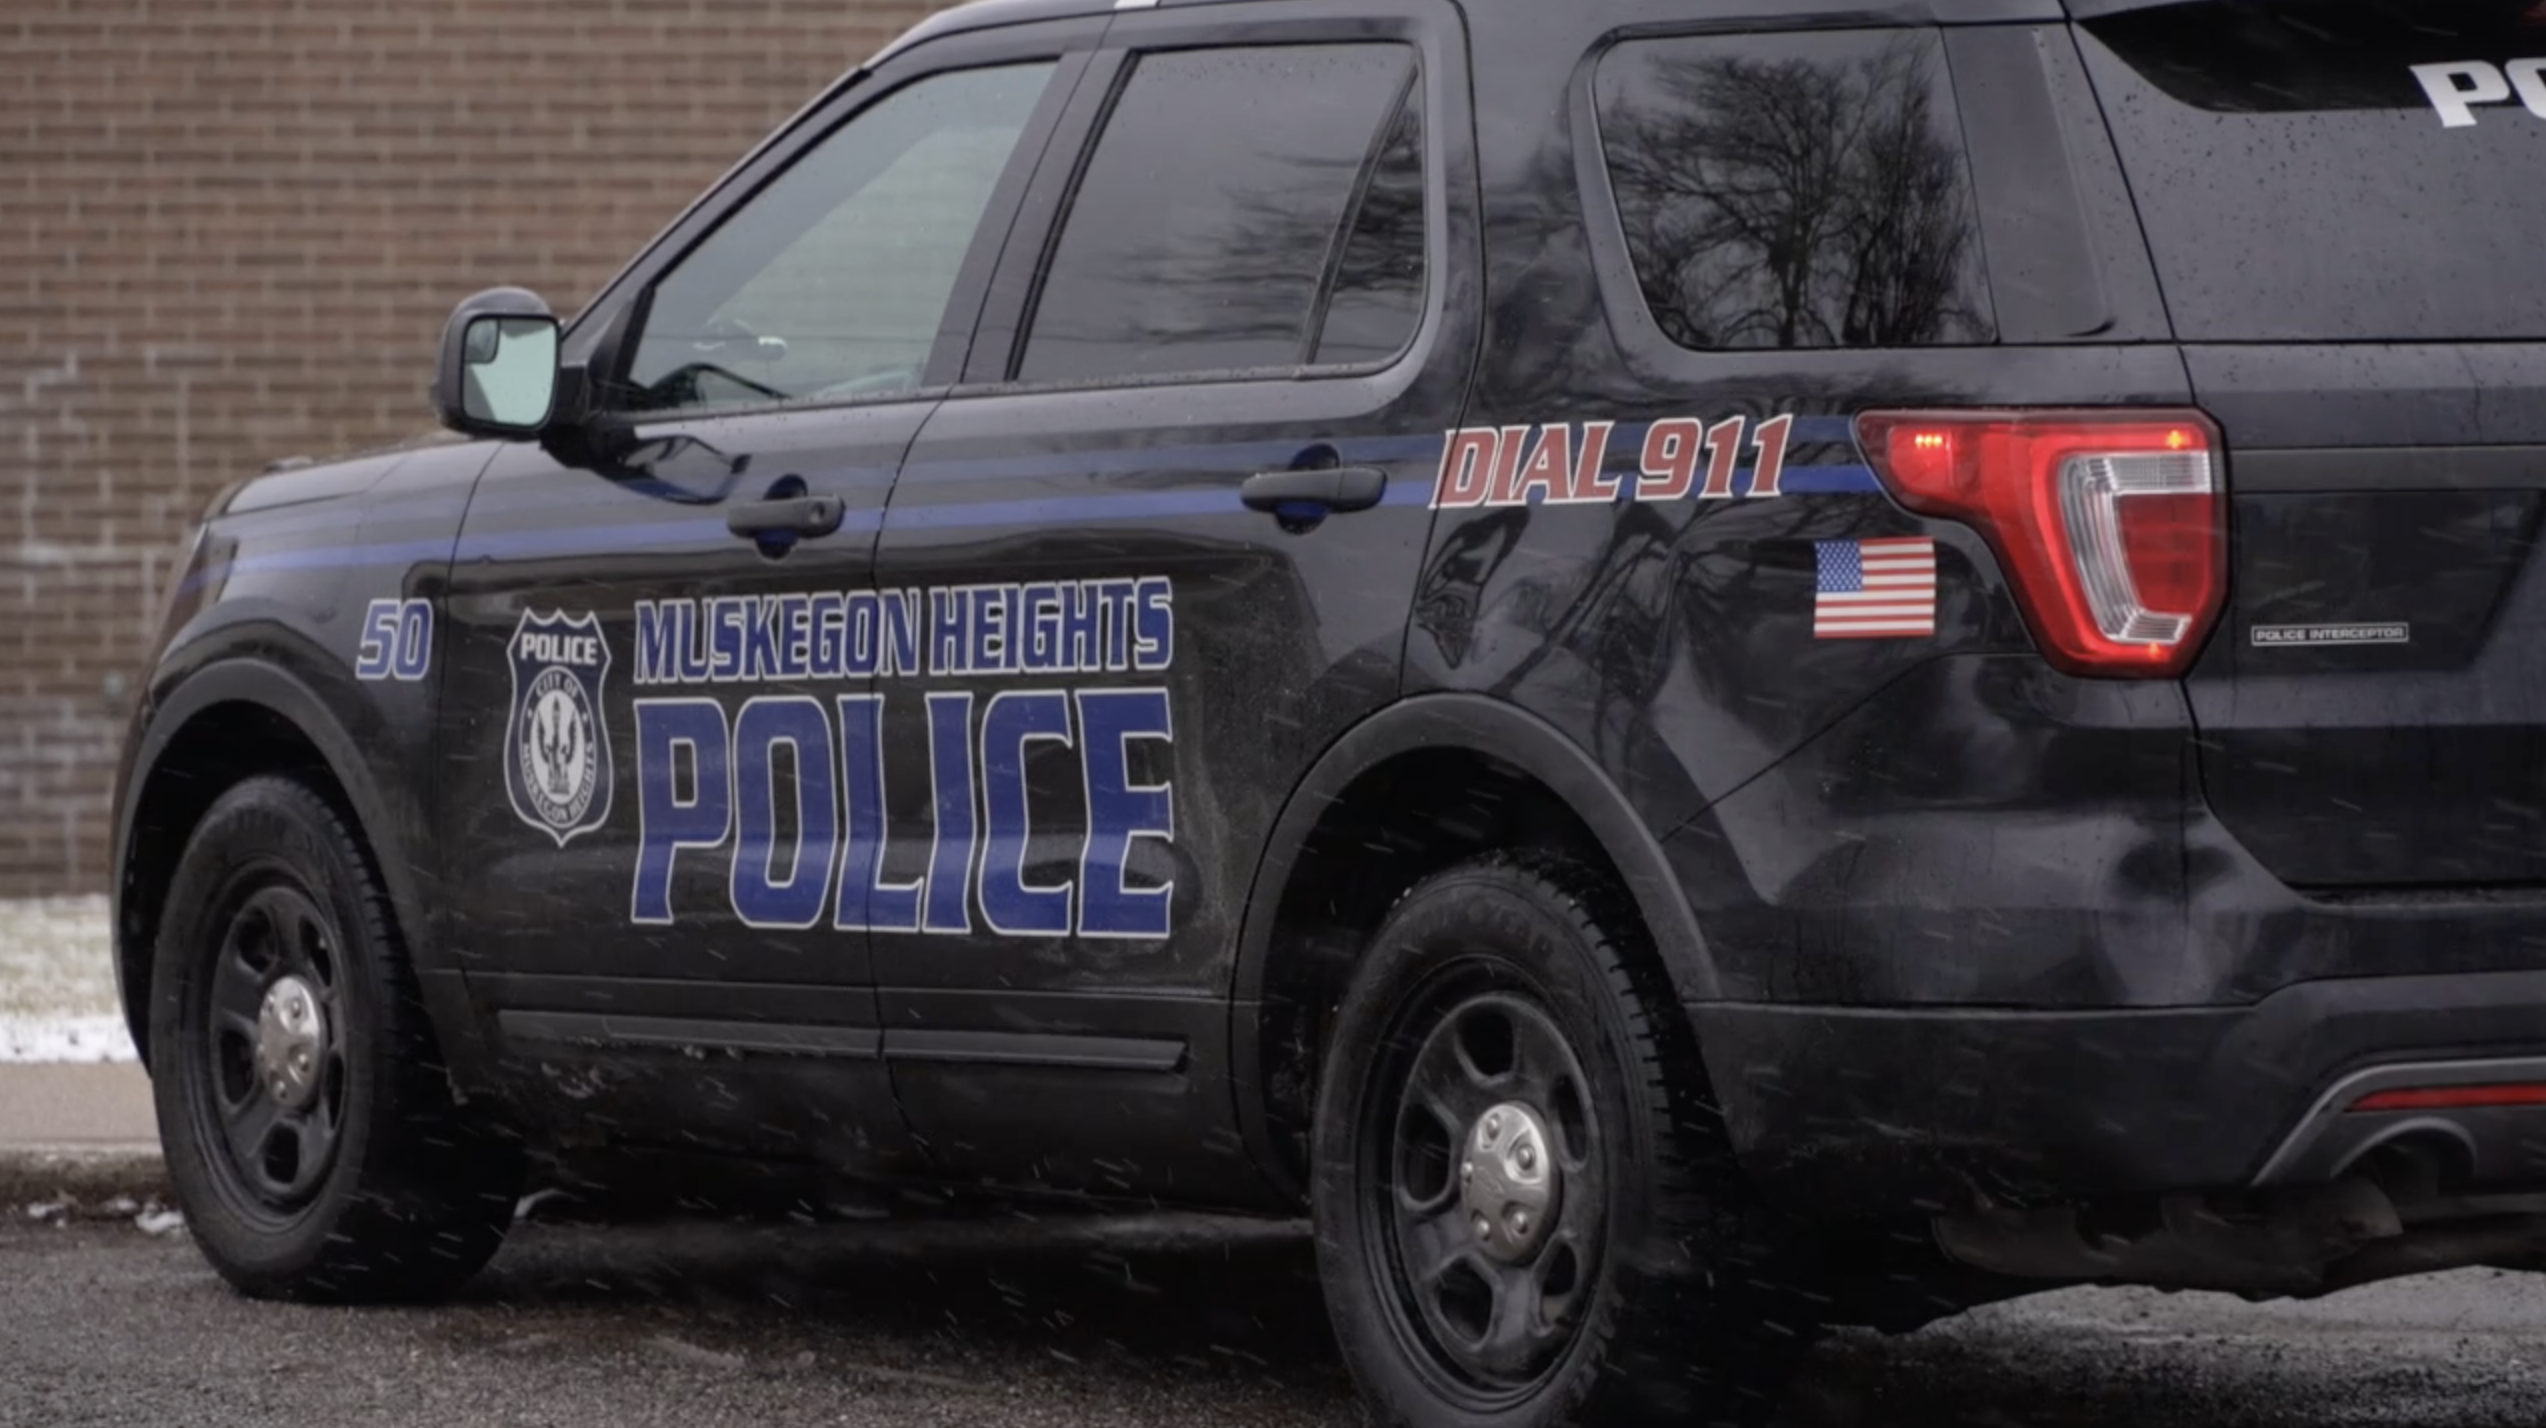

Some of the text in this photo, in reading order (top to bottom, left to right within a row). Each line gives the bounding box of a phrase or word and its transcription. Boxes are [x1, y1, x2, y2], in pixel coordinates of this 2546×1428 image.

[1428, 413, 1793, 510] DIAL 911
[355, 597, 434, 680] 50
[520, 632, 597, 666] POLICE
[633, 576, 1173, 684] MUSKEGON HEIGHTS
[2255, 627, 2404, 641] POLICE INTERCEPTOR
[631, 687, 1173, 939] POLICE
